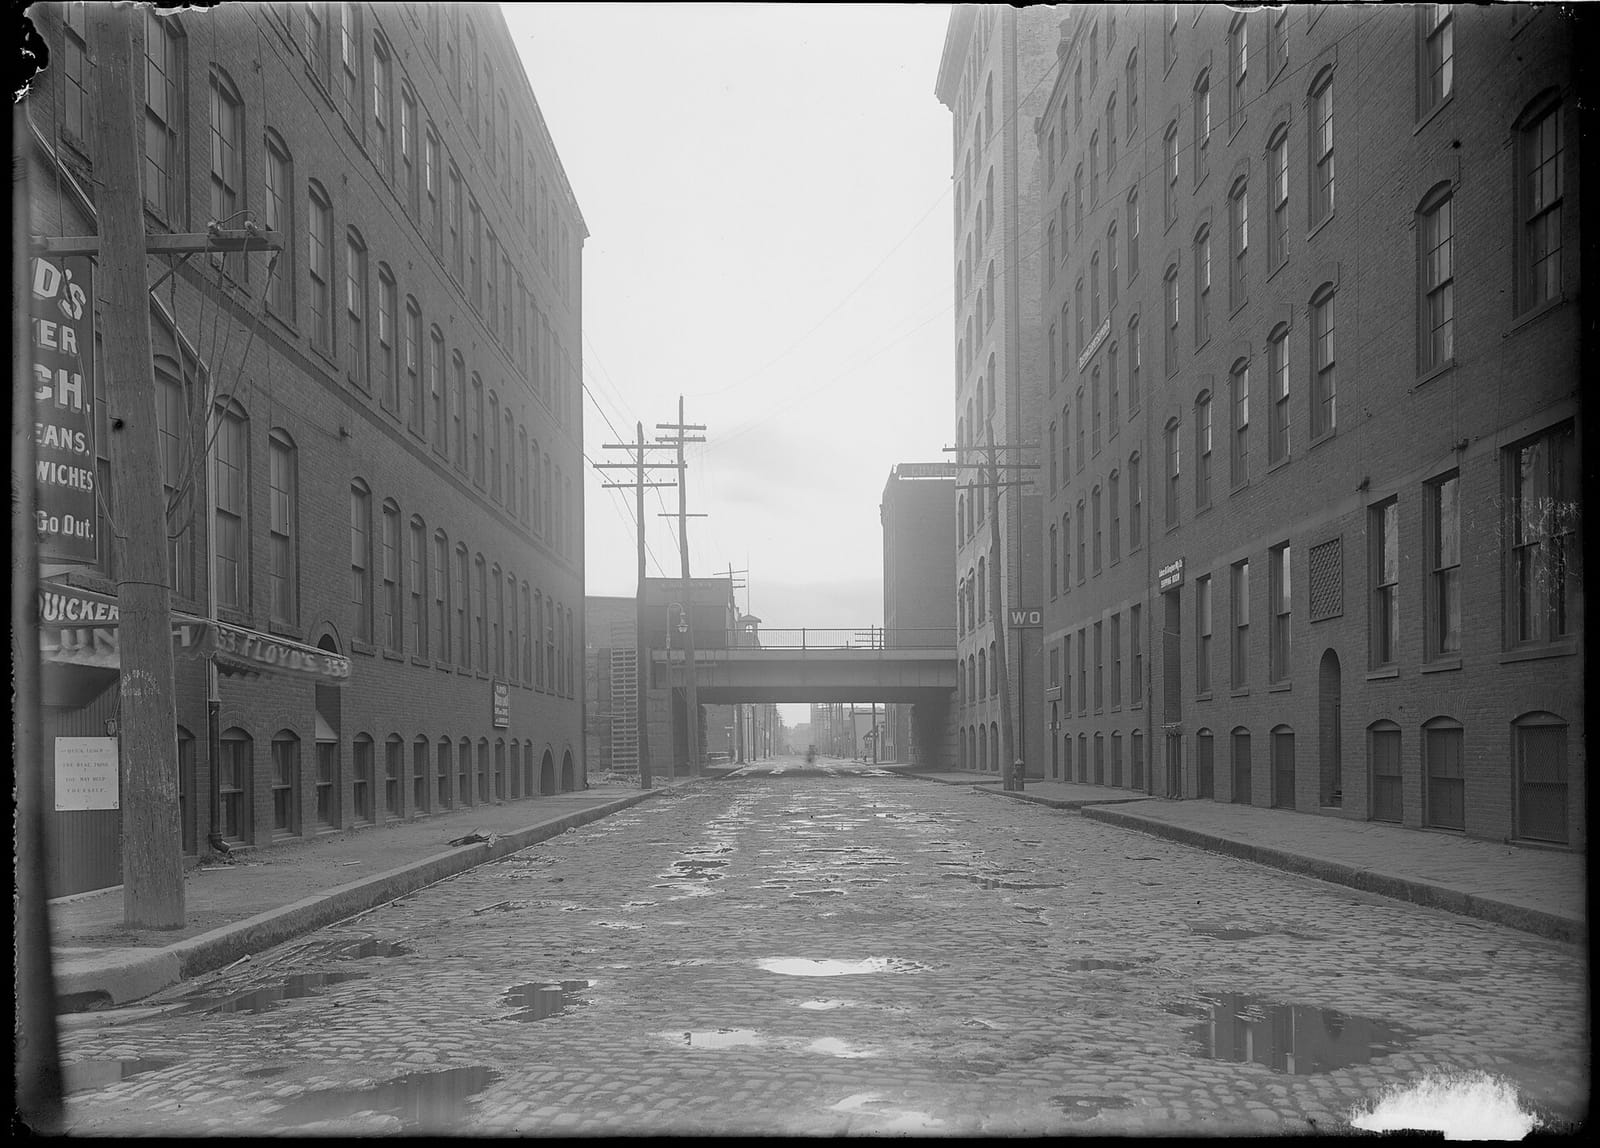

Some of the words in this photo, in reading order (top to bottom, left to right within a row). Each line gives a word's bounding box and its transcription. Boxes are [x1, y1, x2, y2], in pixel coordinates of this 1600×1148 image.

[64, 514, 95, 539] Out.
[39, 592, 119, 621] UICKER
[322, 658, 349, 678] 353
